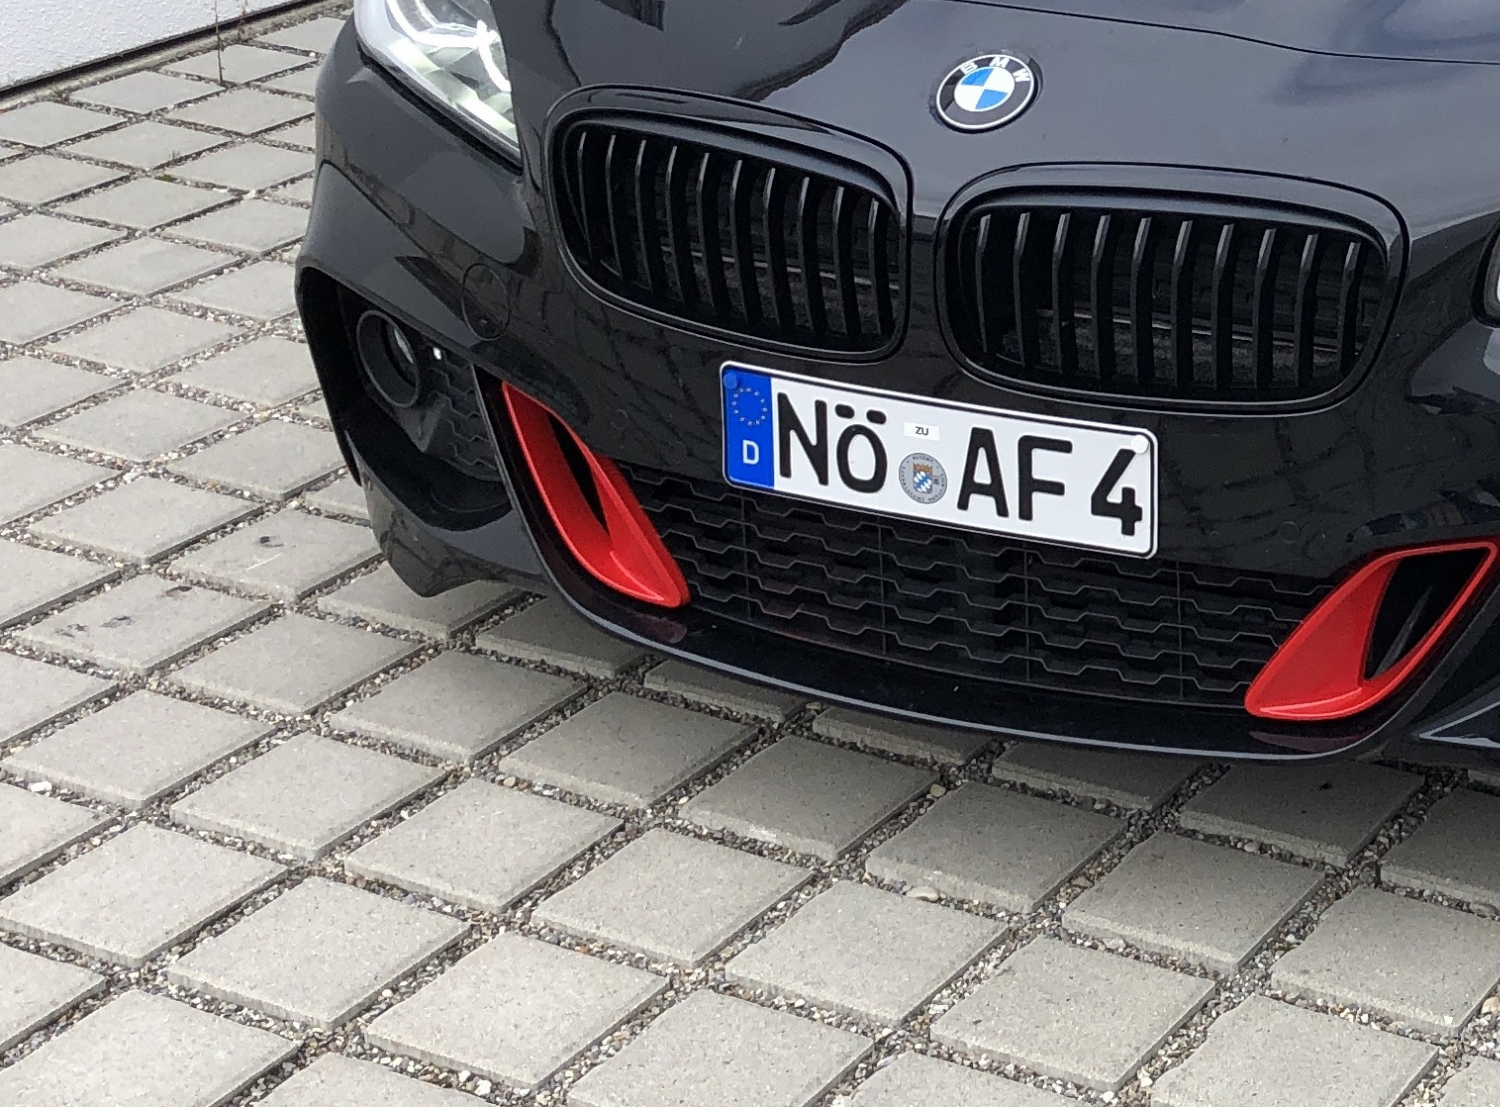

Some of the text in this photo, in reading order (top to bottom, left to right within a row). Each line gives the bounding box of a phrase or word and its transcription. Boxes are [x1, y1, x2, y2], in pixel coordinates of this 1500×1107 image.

[959, 56, 1031, 82] BMW
[742, 439, 760, 465] D
[777, 391, 888, 493] NÖ
[957, 426, 1073, 521] AF
[1090, 448, 1143, 537] 4
